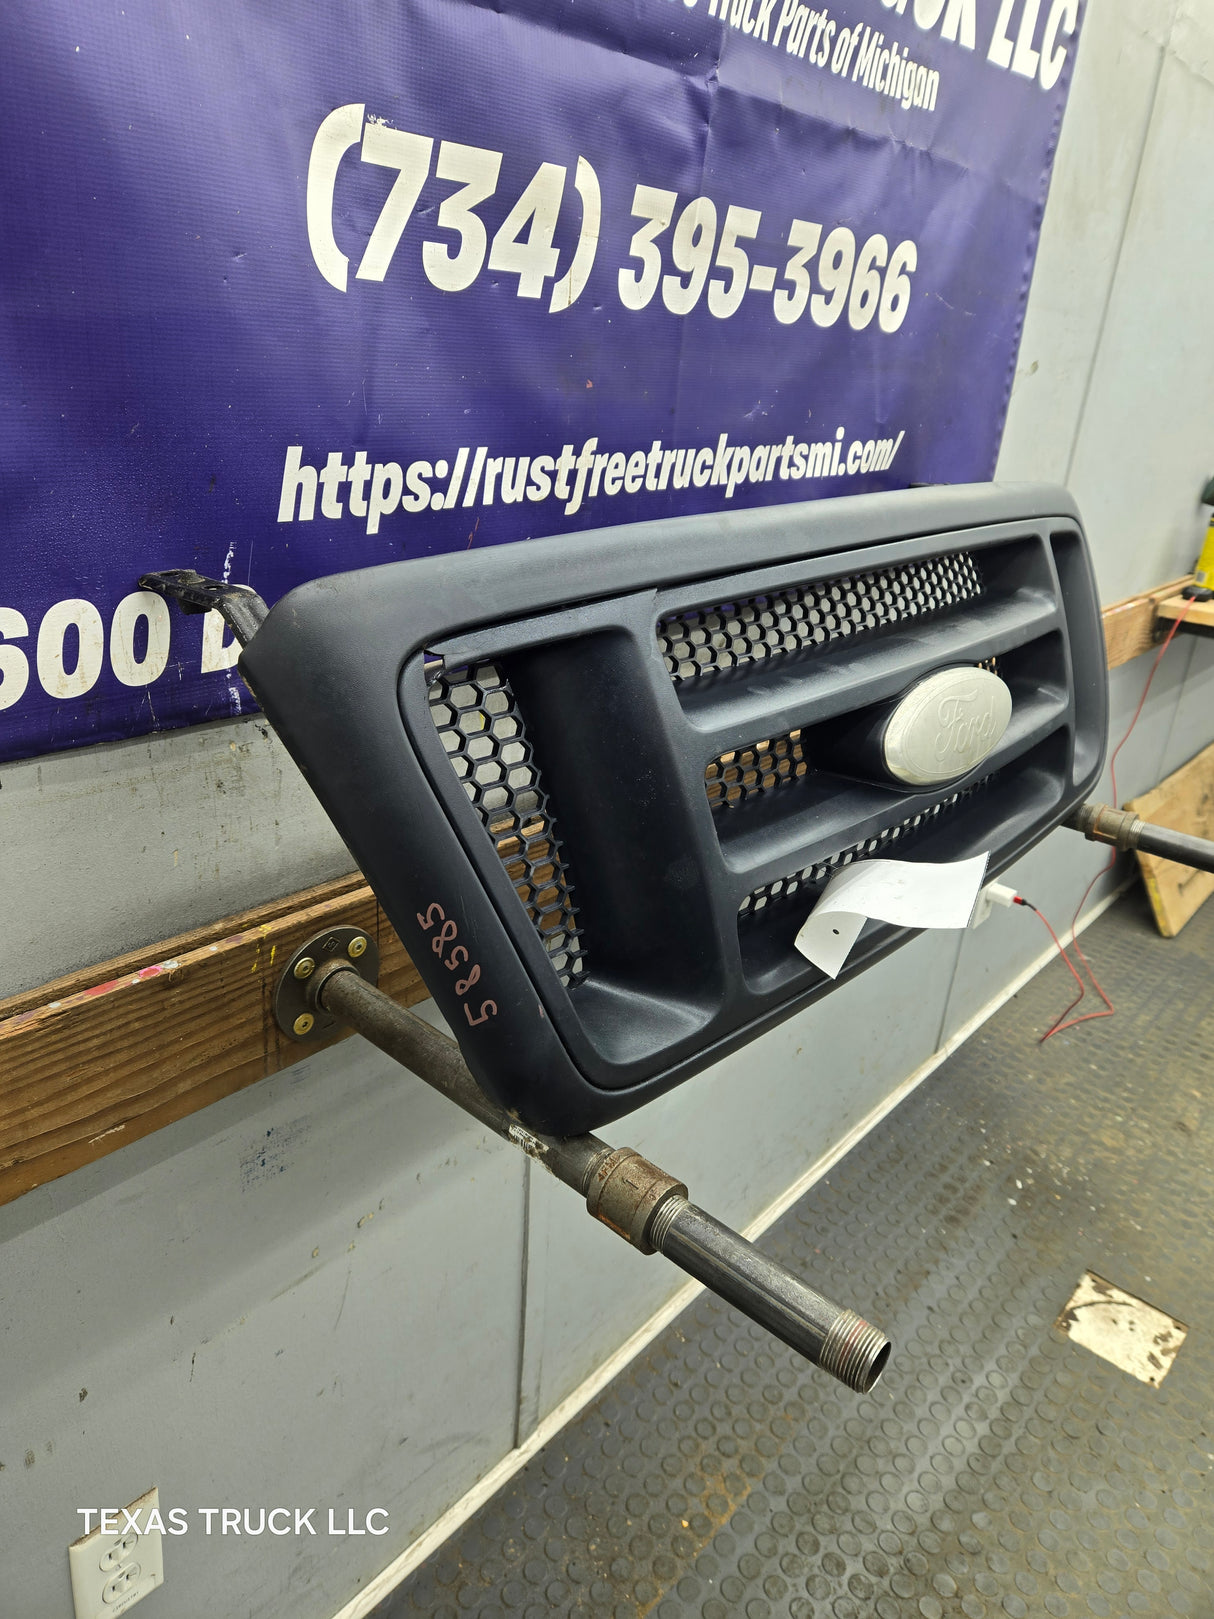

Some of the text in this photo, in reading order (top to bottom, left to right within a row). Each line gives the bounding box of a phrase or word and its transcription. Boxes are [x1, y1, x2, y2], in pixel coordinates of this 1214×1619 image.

[772, 0, 836, 68] Parts
[831, 22, 864, 78] of
[852, 26, 940, 112] Michigan
[986, 0, 1079, 91] LLC
[306, 103, 918, 334] (734) 395-3966
[277, 427, 906, 535] https://rustfreetruckpartsmi.com/
[935, 689, 998, 763] Ford
[417, 903, 498, 1026] 58585
